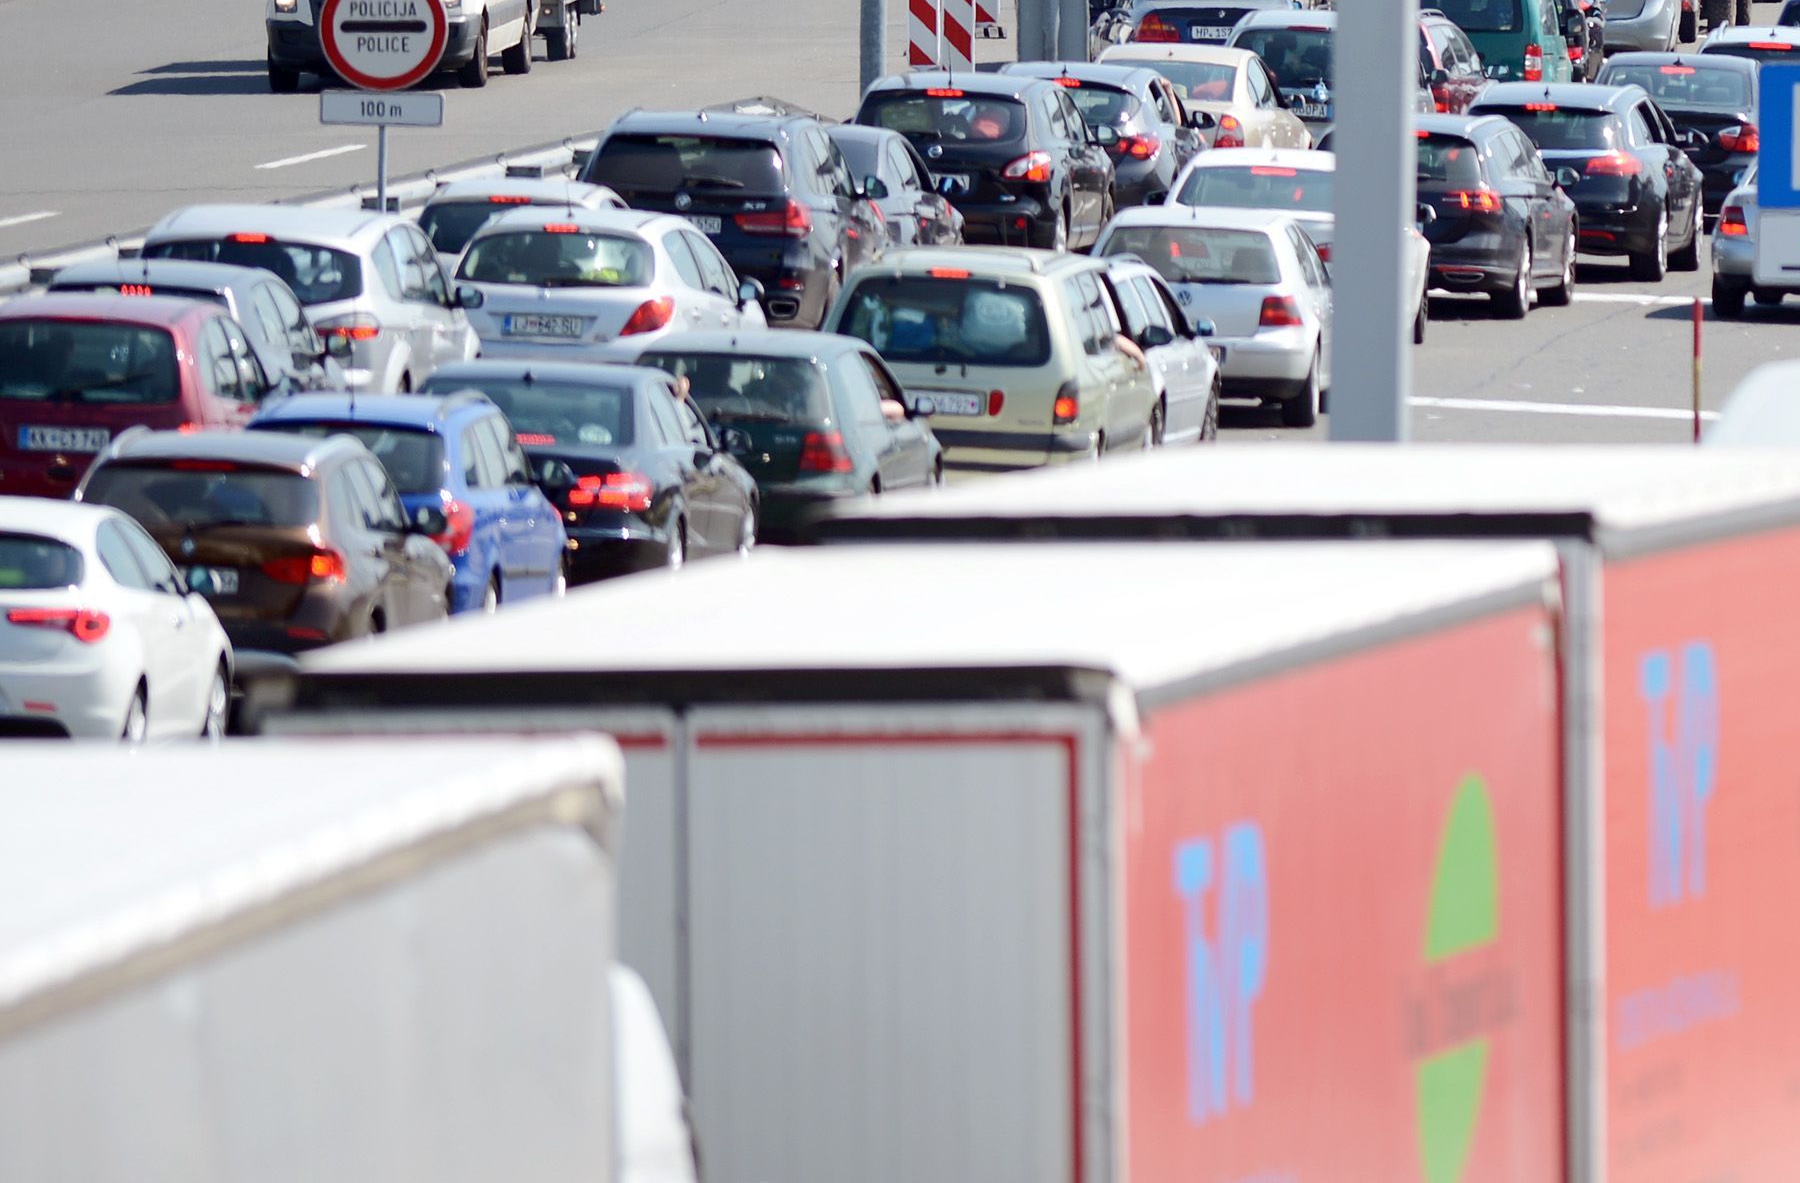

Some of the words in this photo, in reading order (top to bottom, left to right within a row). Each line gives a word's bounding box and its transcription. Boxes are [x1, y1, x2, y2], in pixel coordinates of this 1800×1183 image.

[350, 1, 418, 17] POLICIJA
[357, 36, 410, 53] POLICE
[361, 101, 386, 117] 100
[390, 105, 402, 117] m
